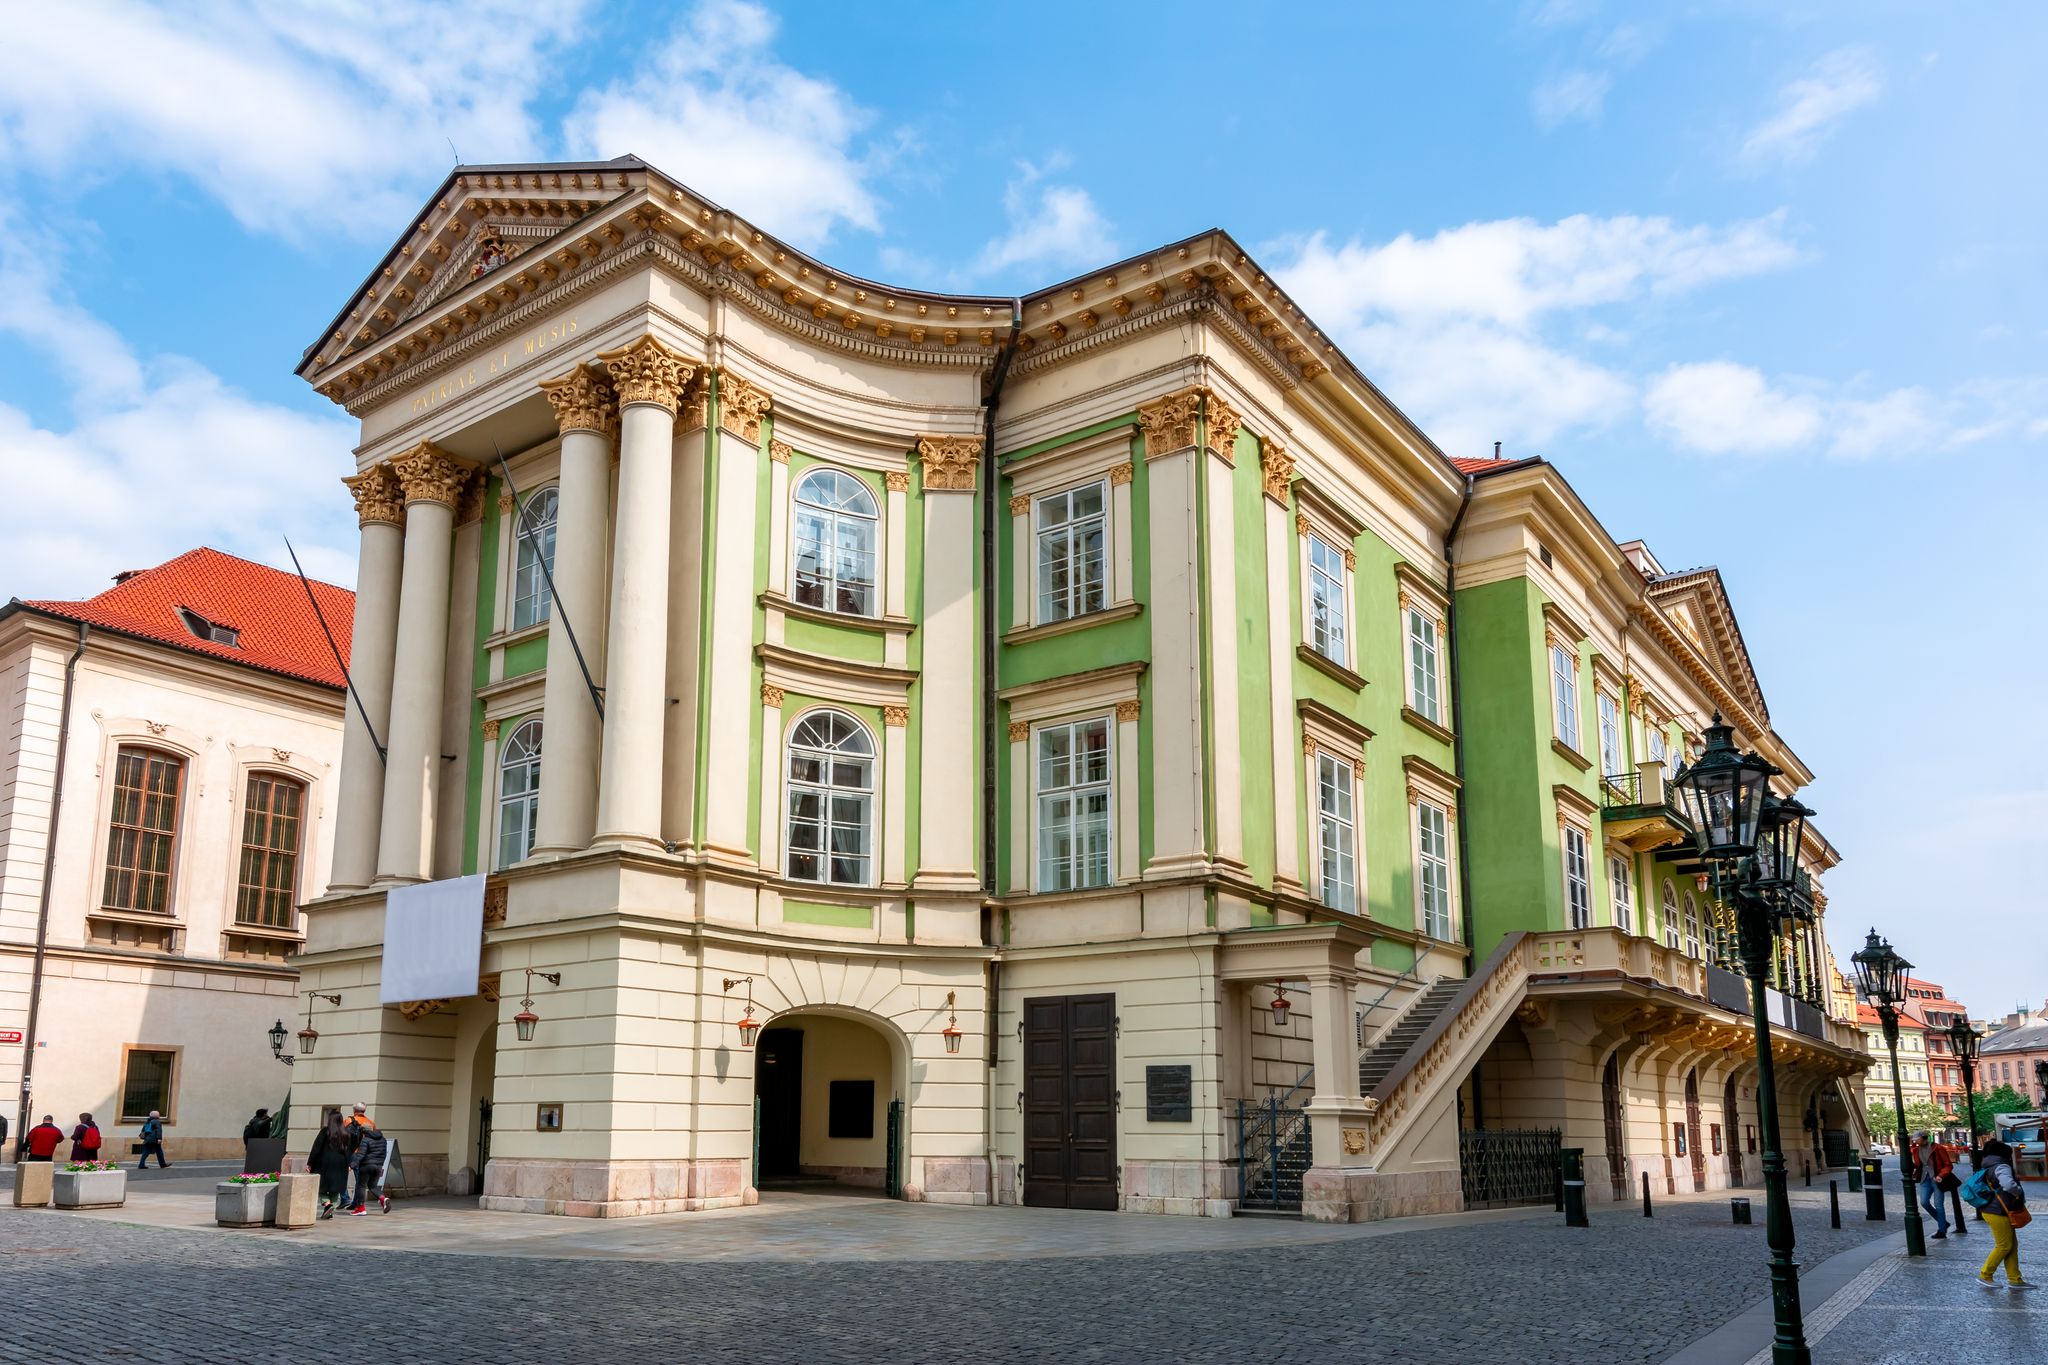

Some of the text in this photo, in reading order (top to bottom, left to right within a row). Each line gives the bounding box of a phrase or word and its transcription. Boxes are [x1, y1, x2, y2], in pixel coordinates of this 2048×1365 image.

[412, 317, 578, 414] PATRIAE ET MUSIS
